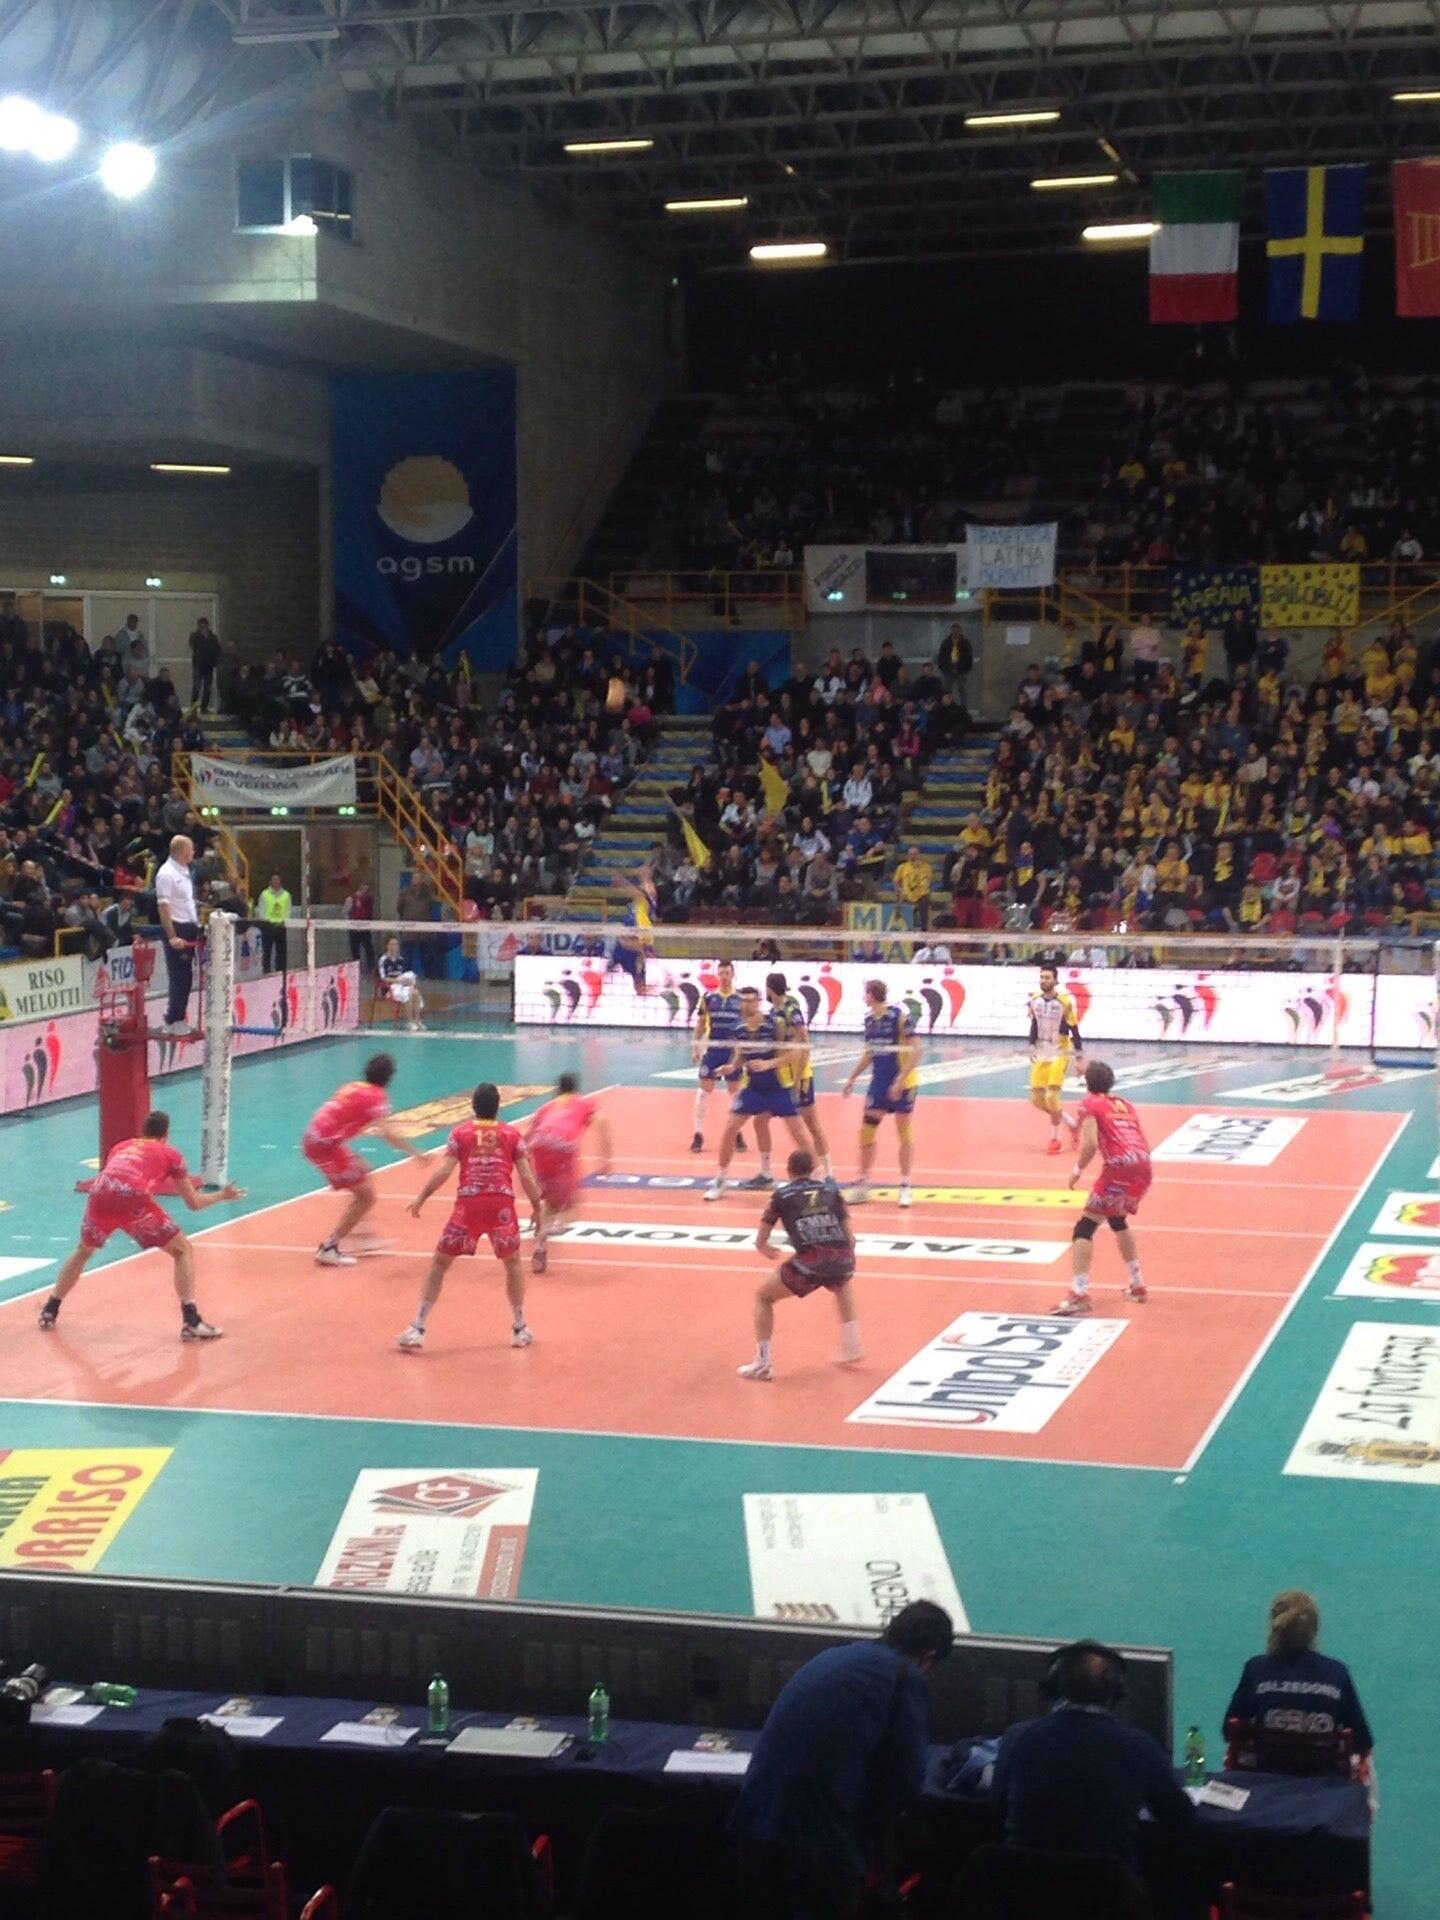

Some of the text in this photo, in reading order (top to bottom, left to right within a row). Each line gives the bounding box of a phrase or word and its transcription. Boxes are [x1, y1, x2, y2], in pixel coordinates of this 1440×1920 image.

[376, 555, 475, 582] agsm
[233, 779, 299, 790] VERONA
[28, 967, 65, 990] RISO
[16, 987, 80, 1015] MELOTTI
[474, 1129, 498, 1147] 13
[804, 1190, 819, 1205] 7
[858, 1316, 1083, 1425] UnipolSai
